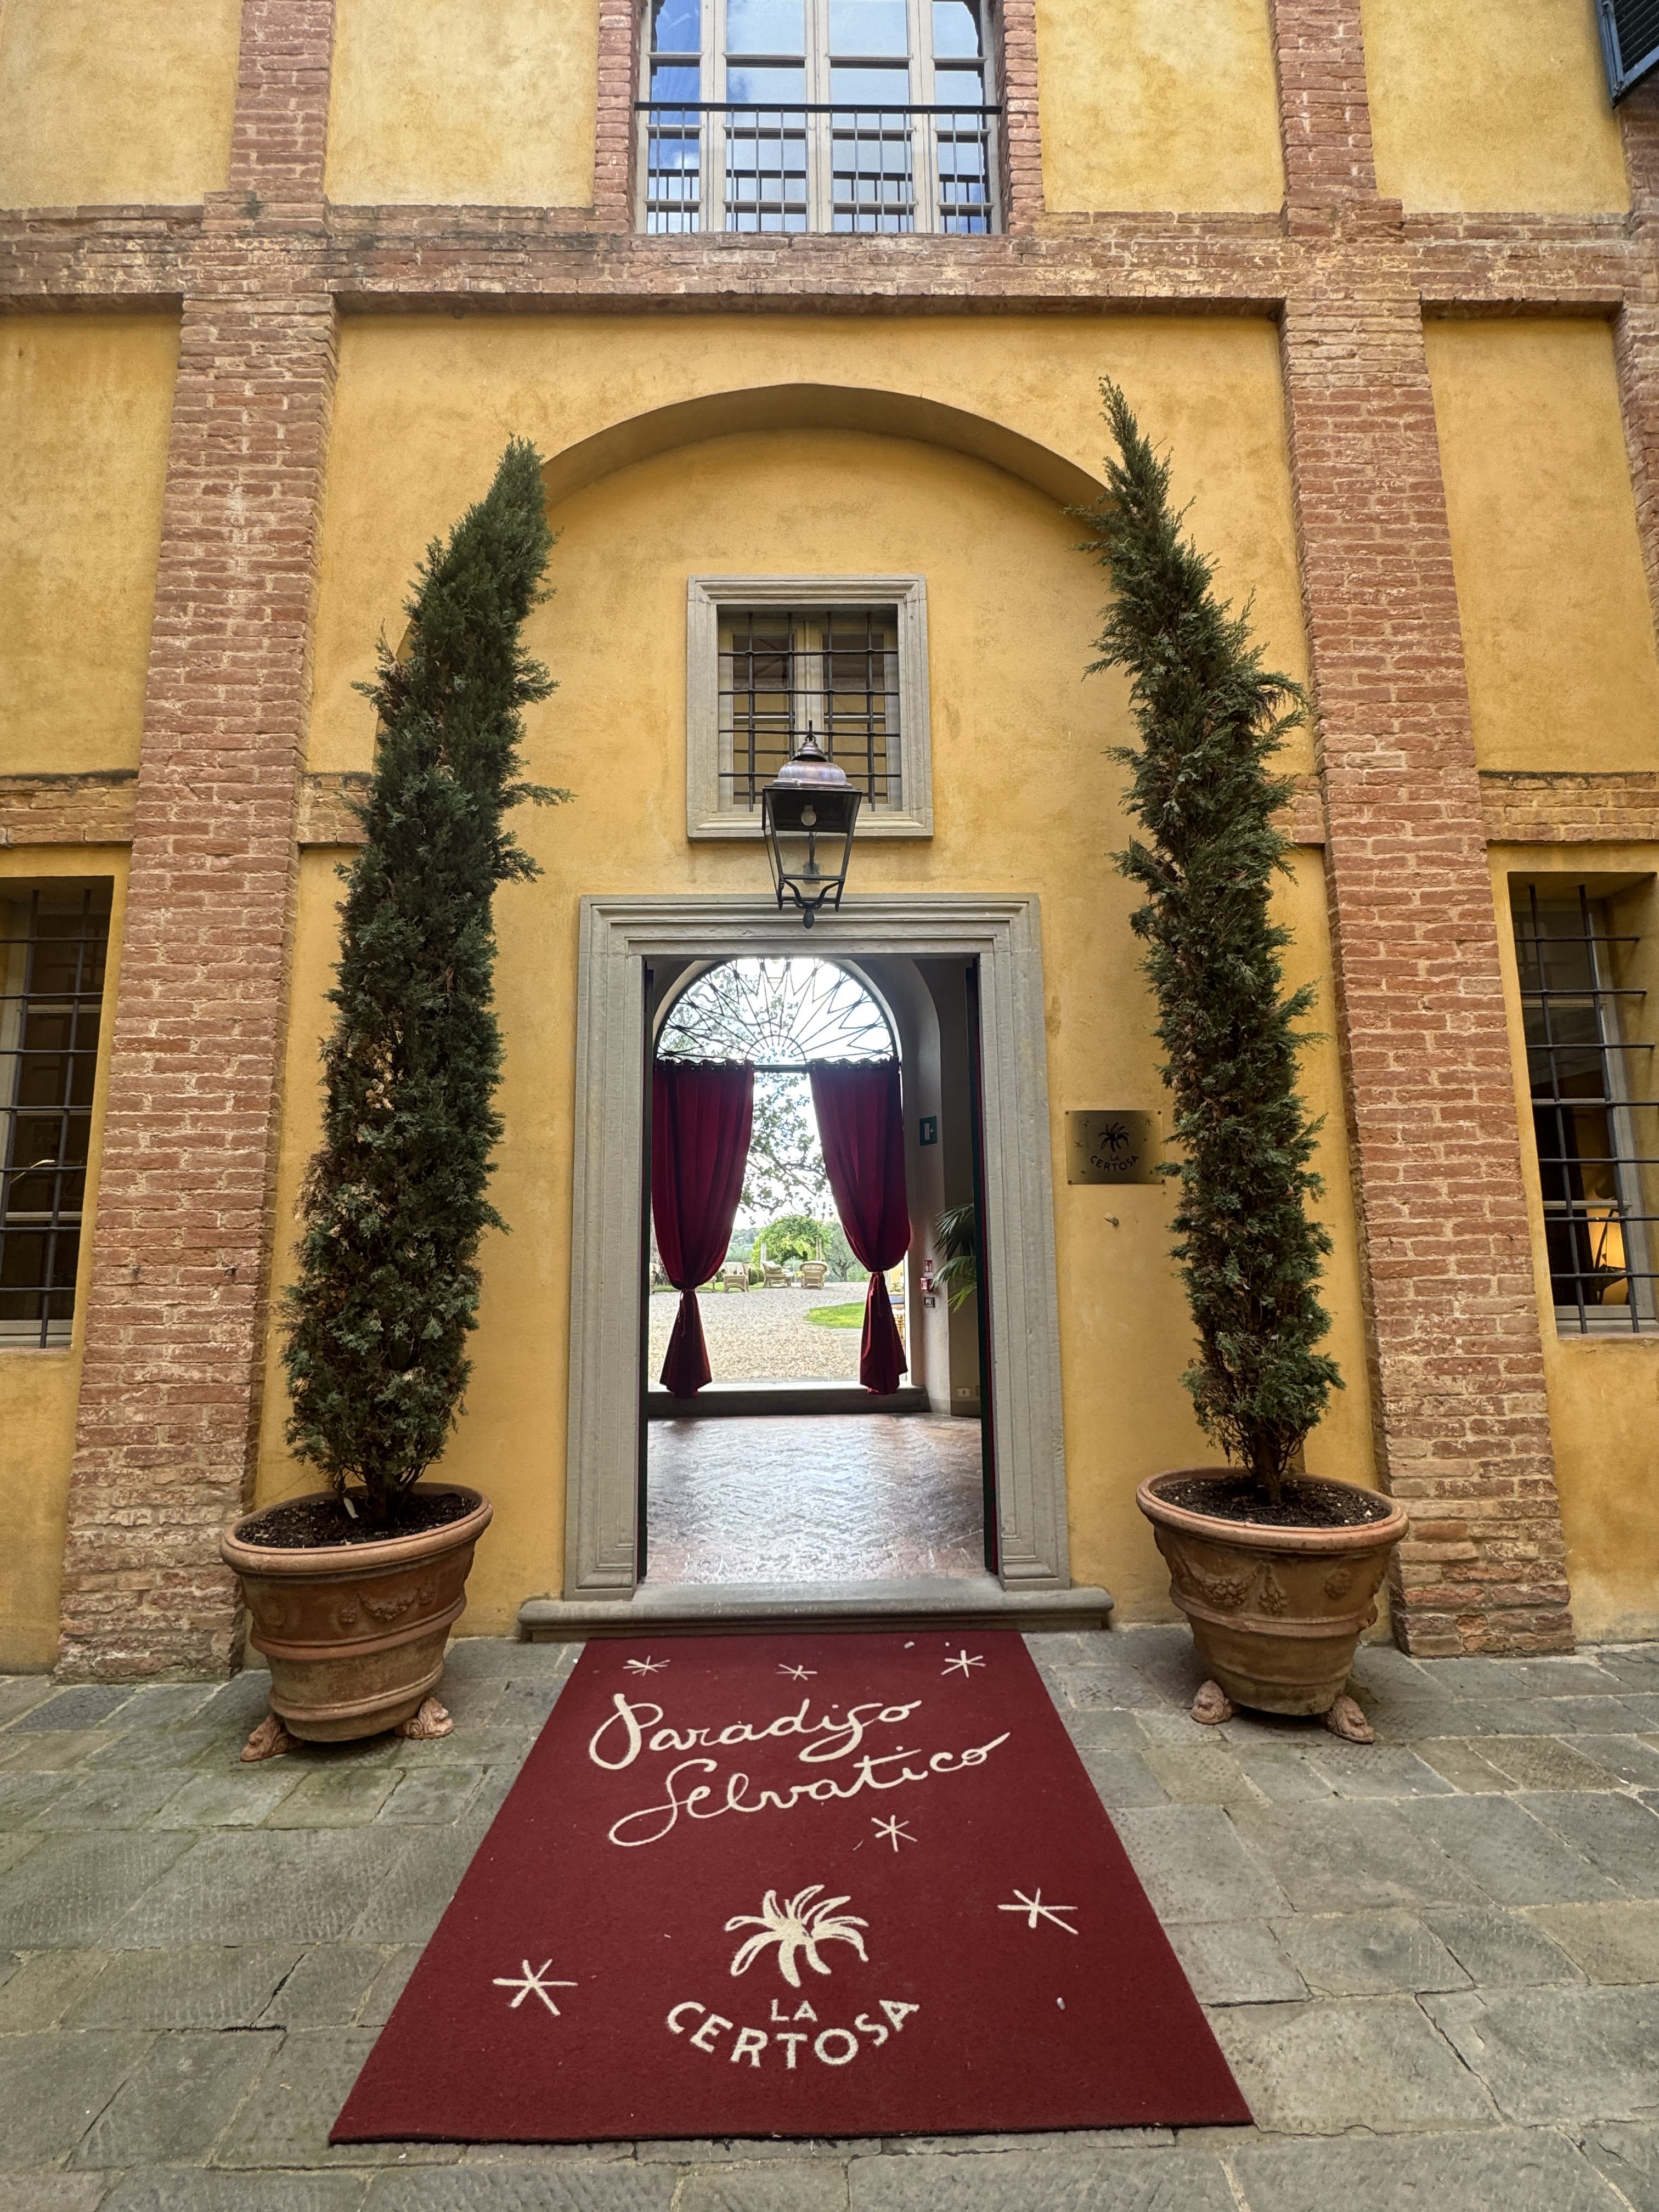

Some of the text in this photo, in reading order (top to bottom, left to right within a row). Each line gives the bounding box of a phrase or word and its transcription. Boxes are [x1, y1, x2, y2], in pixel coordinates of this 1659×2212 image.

[1090, 1155, 1139, 1172] CERTOSA
[588, 1693, 922, 1770] Paradiso
[608, 1732, 1011, 1847] Selvatico
[667, 2000, 919, 2069] CERTOSA
[771, 1999, 818, 2022] LA
